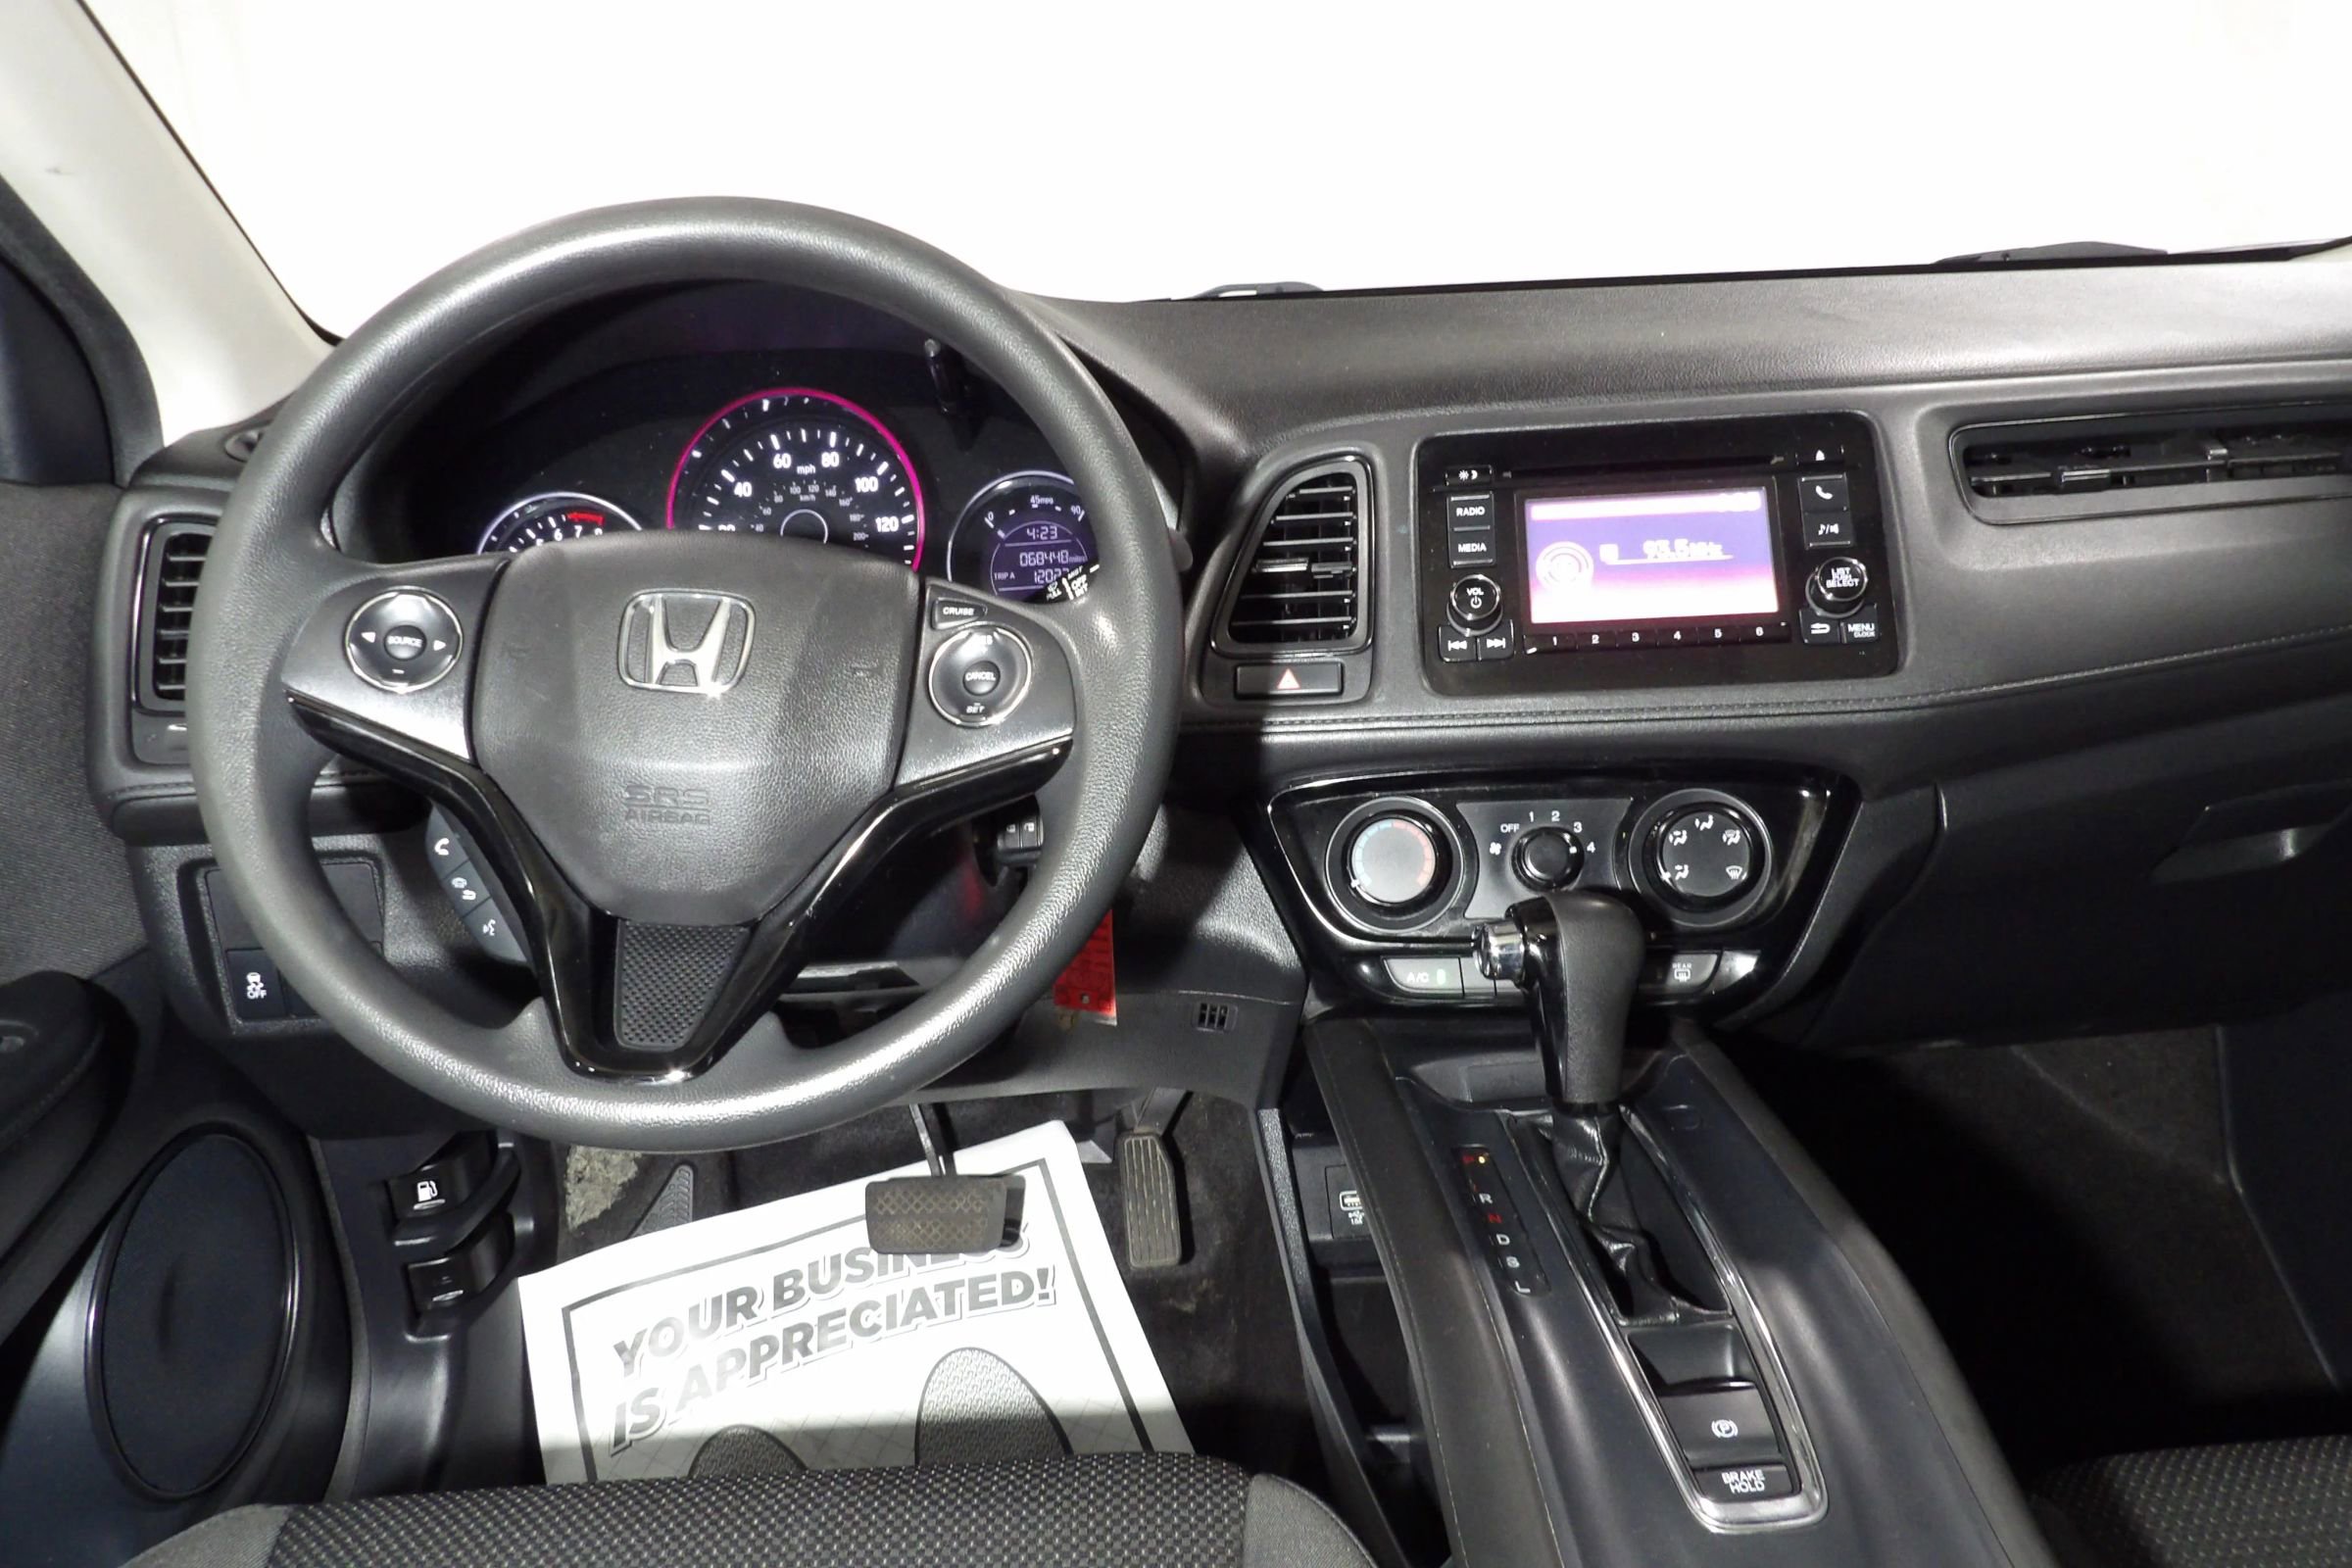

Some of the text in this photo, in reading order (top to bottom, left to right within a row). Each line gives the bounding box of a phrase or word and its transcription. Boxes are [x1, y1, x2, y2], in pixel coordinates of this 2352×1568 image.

[773, 453, 792, 469] 60
[821, 451, 840, 468] 80
[796, 464, 816, 476] mph
[734, 481, 753, 498] 40
[854, 476, 879, 493] 100
[1455, 506, 1486, 517] RADIO
[573, 524, 583, 539] 7
[875, 516, 900, 533] 120
[554, 527, 564, 542] 6
[1026, 526, 1058, 540] 4:23
[1457, 542, 1488, 553] MEDIA
[1019, 550, 1069, 567] 068448
[1009, 571, 1015, 580] A
[1826, 578, 1860, 588] SELECT
[1466, 587, 1485, 597] VOL
[942, 606, 975, 616] CRUISE
[1847, 622, 1876, 633] MENU
[387, 635, 423, 648] SOURCE
[1552, 626, 1764, 647] 1 2 3 4 5 6
[964, 671, 997, 681] CANCEL
[965, 705, 985, 713] SET
[624, 783, 709, 806] SRS
[624, 808, 711, 825] AIRBAG
[1499, 809, 1596, 854] OFF 1 2 3 4
[1406, 971, 1430, 983] A/C
[247, 989, 268, 1000] OFF
[1479, 1193, 1494, 1204] R
[1488, 1212, 1503, 1224] N
[1495, 1233, 1511, 1247] D
[1514, 1280, 1532, 1294] L
[612, 1237, 1025, 1379] YOUR BUSI
[612, 1266, 1051, 1448] IS APPRECIATED!
[1721, 1469, 1766, 1484] BRAKE
[1730, 1480, 1766, 1494] HOLD
